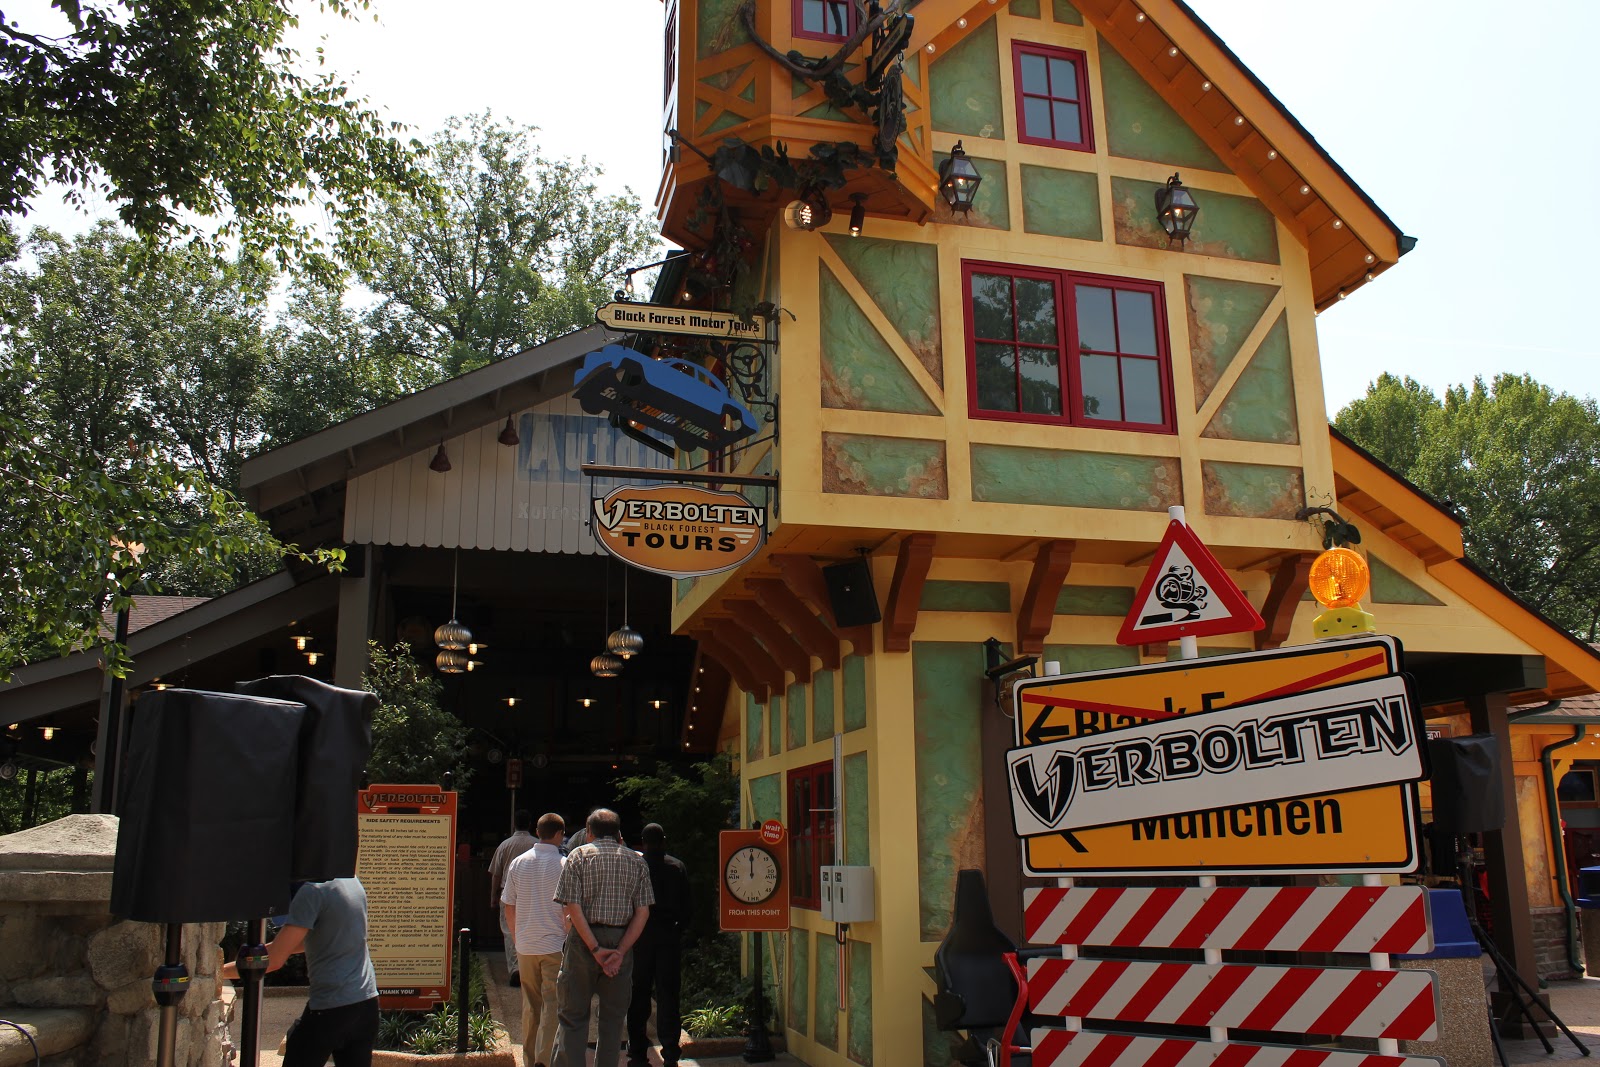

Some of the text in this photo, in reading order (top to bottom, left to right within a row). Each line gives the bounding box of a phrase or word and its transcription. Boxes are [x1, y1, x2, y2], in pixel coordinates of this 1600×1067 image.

[614, 309, 646, 322] Black
[649, 312, 686, 326] Forest
[690, 316, 725, 329] Motor
[594, 498, 764, 530] VERBOLTEN
[644, 522, 715, 534] BLACK FOREST
[622, 532, 736, 552] TOURS
[1011, 694, 1413, 828] VERBOLTEN
[362, 793, 446, 808] VERBOLTEN
[764, 831, 780, 839] time
[765, 824, 780, 832] wait
